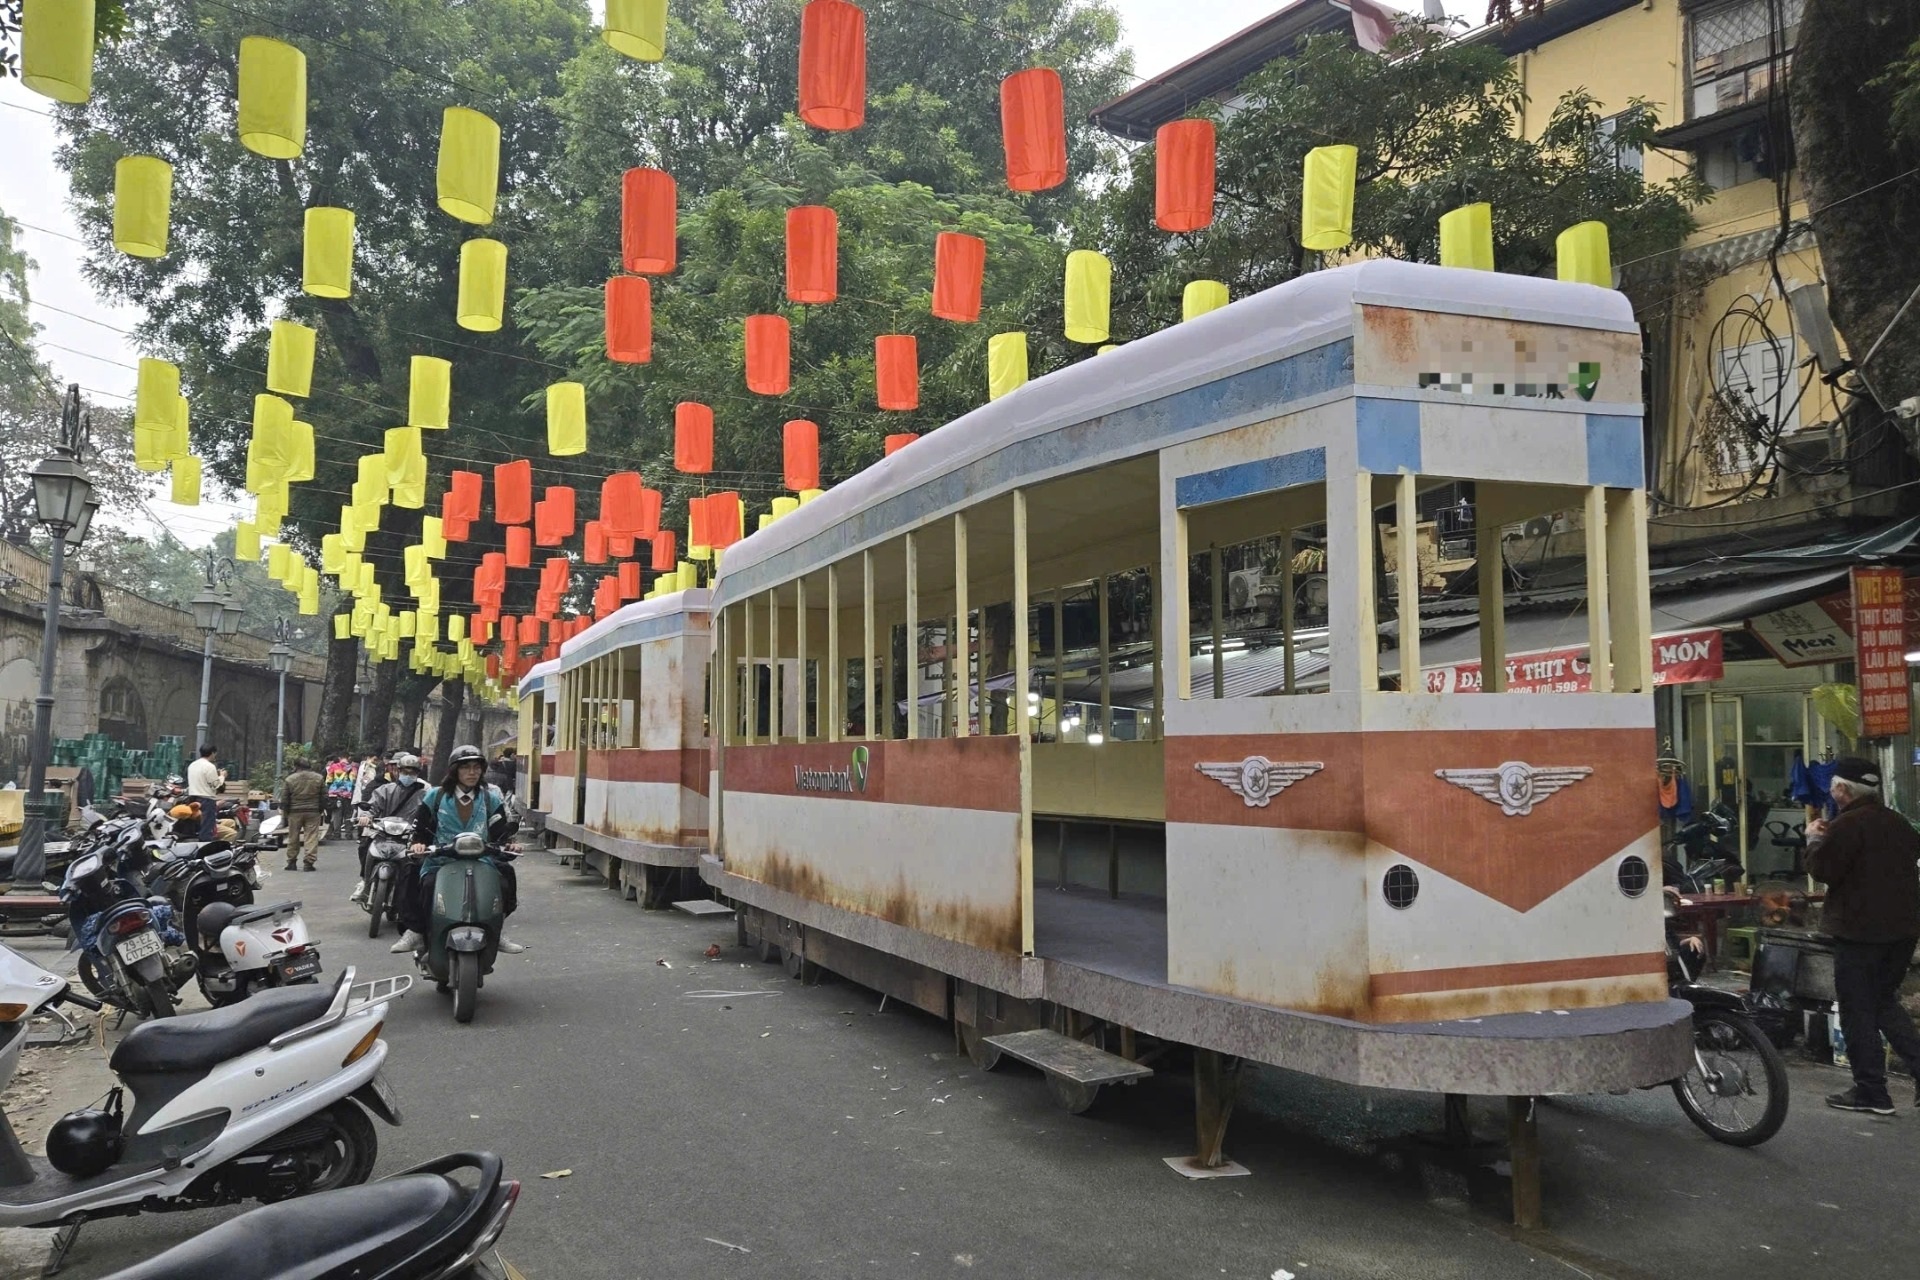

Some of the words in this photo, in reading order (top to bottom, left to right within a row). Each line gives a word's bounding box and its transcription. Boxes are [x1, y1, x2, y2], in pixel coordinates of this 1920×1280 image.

[1885, 576, 1901, 592] 33
[1427, 672, 1446, 693] 33
[1460, 672, 1482, 692] ĐẠ
[1522, 658, 1566, 682] THỊT
[1659, 638, 1711, 665] MÓN
[794, 764, 853, 793] Vietcombank
[294, 963, 315, 972] YADEA
